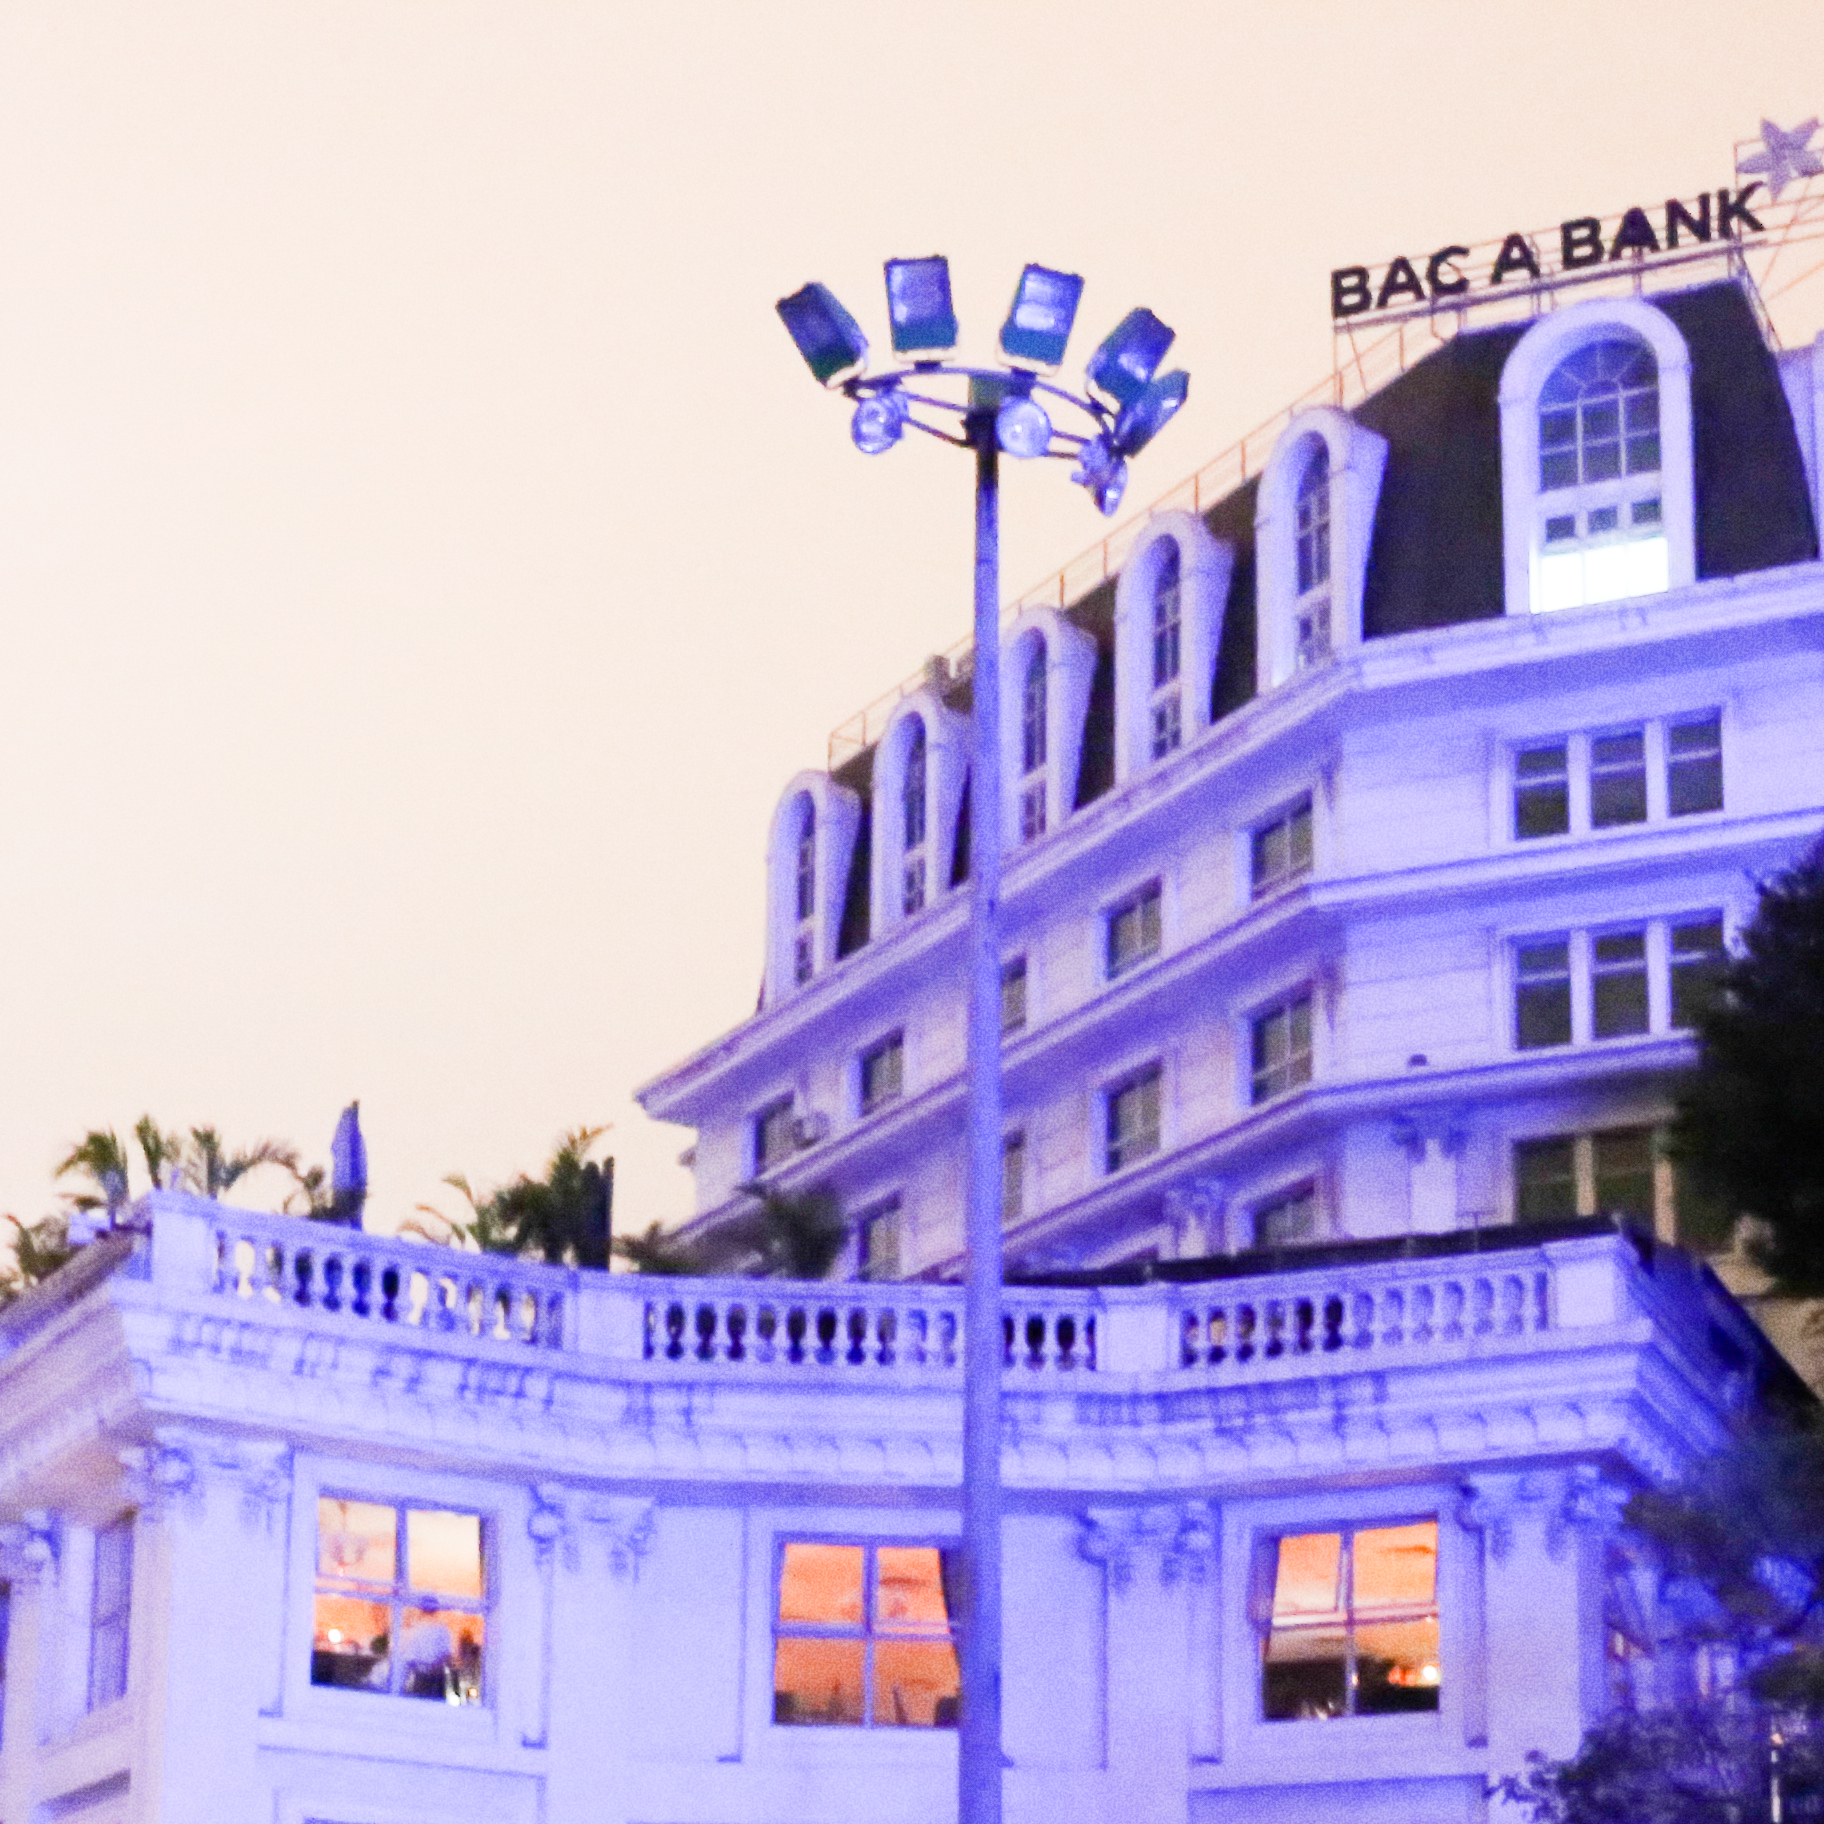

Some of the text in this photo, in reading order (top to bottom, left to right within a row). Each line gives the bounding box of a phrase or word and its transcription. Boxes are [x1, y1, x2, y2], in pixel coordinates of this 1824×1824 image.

[1330, 180, 1766, 318] BAC A BANK
